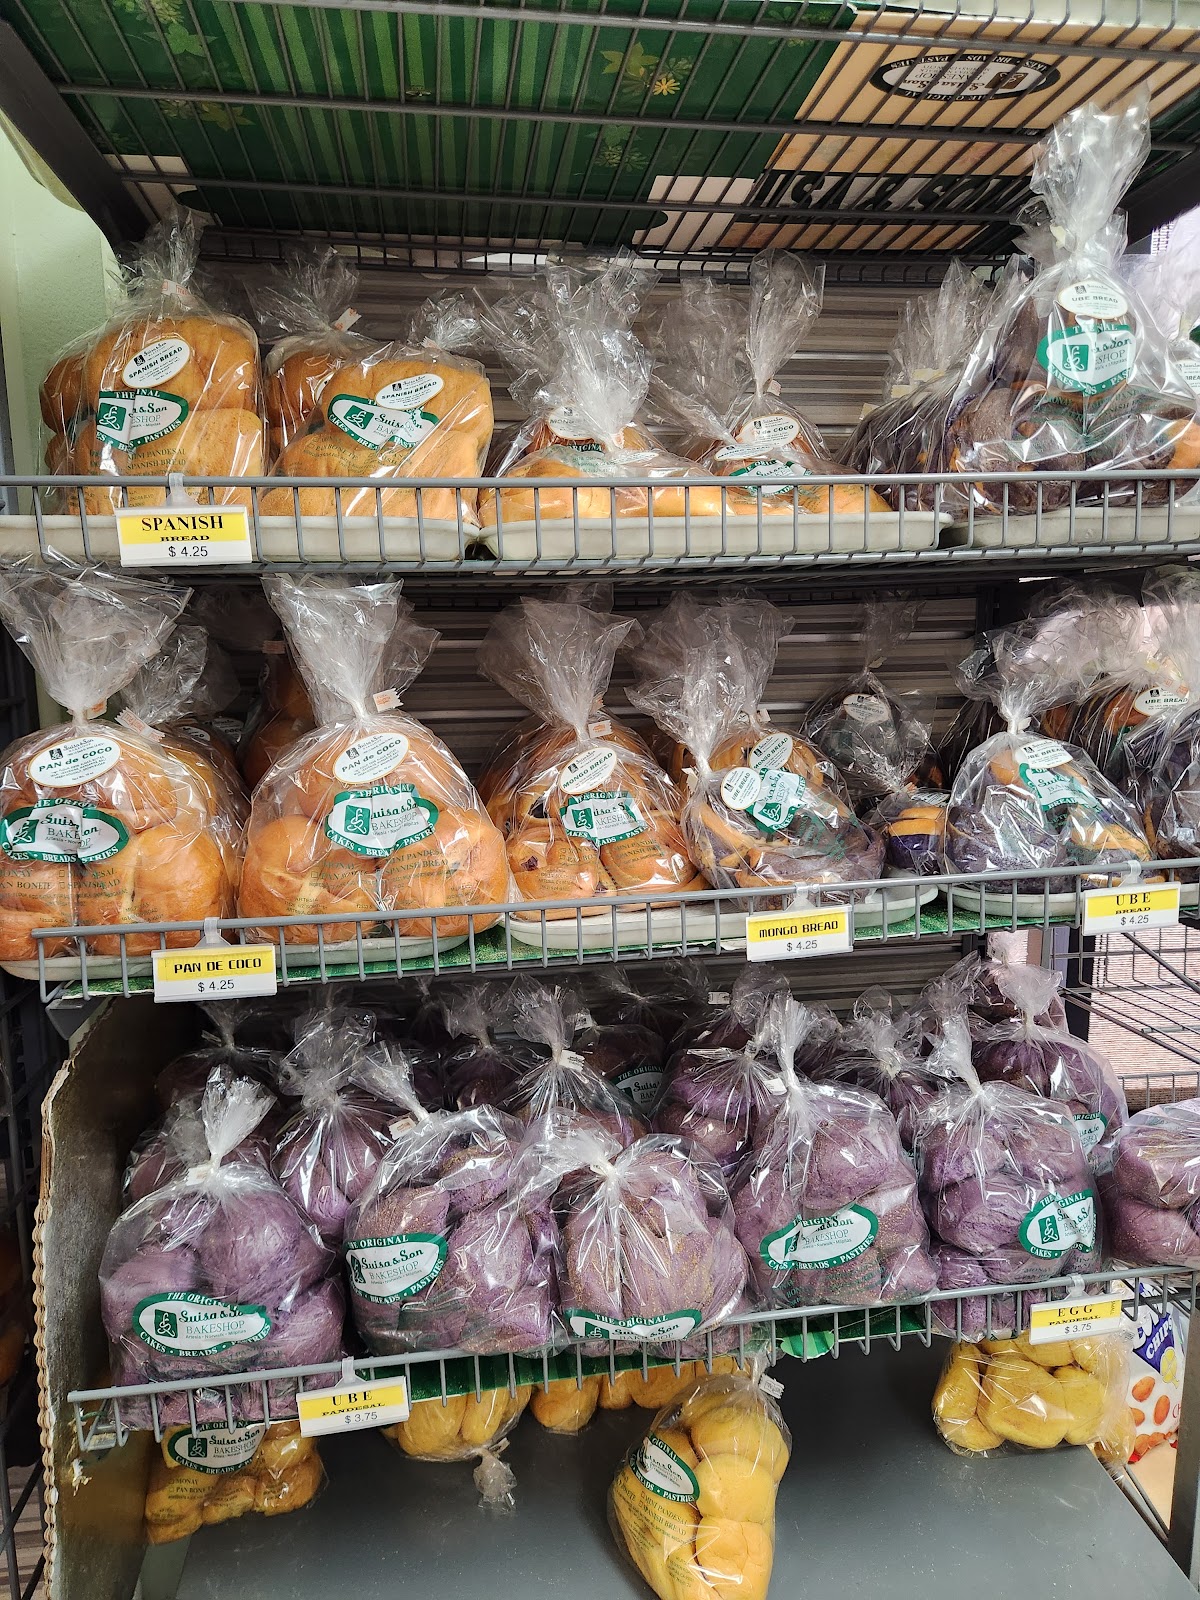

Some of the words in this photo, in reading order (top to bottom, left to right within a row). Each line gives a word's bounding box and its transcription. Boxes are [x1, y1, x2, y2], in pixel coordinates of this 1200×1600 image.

[890, 55, 950, 70] PASTIES
[128, 359, 159, 379] SPANISH
[159, 346, 183, 362] BREAD
[114, 391, 136, 399] THE
[381, 390, 414, 400] SPANISH
[414, 381, 438, 394] BREAD
[143, 418, 183, 444] PASTRIES
[329, 413, 350, 433] CAKES
[773, 424, 794, 434] COCO
[142, 515, 224, 531] SPANISH
[168, 545, 177, 558] $
[180, 546, 208, 557] 4.25
[38, 762, 62, 772] PAN
[82, 746, 112, 760] COCO
[341, 760, 361, 773] PAN
[363, 754, 374, 762] de
[376, 739, 401, 755] COCO
[753, 753, 772, 769] MONGO
[771, 737, 789, 755] BREAD
[563, 769, 589, 789] MONGO
[590, 752, 613, 771] BREAD
[372, 783, 412, 796] RIGINAL
[731, 788, 741, 801] UBE
[739, 772, 751, 791] BREAD
[371, 807, 400, 820] uisa
[326, 829, 355, 851] CAKES
[2, 841, 30, 861] CAKES
[42, 853, 78, 863] BREADS
[1116, 892, 1151, 906] UBE
[1115, 906, 1151, 915] BREAD
[1120, 917, 1127, 926] $
[1129, 915, 1149, 925] 4.25
[759, 925, 798, 938] MONGO
[802, 920, 838, 933] BREAD
[786, 942, 793, 952] $
[796, 940, 818, 951] 4.25
[174, 962, 201, 974] PAN
[206, 961, 224, 972] DE
[228, 957, 261, 970] COCO
[197, 981, 205, 993] $
[209, 979, 235, 991] 4.25
[359, 1234, 409, 1247] ORIGINAL
[839, 1233, 875, 1263] PASTRIES
[361, 1256, 392, 1270] Suisa
[392, 1256, 401, 1265] &
[400, 1248, 424, 1262] Son
[1030, 1246, 1052, 1258] CAKES
[368, 1260, 420, 1280] BAKESHOP
[409, 1257, 444, 1295] PASTRIES
[167, 1292, 186, 1301] THE
[178, 1309, 218, 1324] Suisa
[219, 1309, 230, 1319] &
[1057, 1304, 1093, 1317] EGG
[185, 1319, 245, 1335] BAKESHOP
[594, 1314, 616, 1325] THE
[618, 1314, 669, 1328] ORIGINAL
[1048, 1315, 1101, 1326] PANDESAL
[1064, 1326, 1070, 1334] $
[1072, 1322, 1092, 1333] 3.75
[658, 1323, 680, 1335] Son
[139, 1331, 168, 1354] CAKES
[178, 1346, 219, 1358] BREADS
[331, 1390, 373, 1406] UBE
[321, 1402, 385, 1417] PANDESAL
[344, 1415, 352, 1425] $
[354, 1411, 378, 1423] 3.75
[208, 1434, 236, 1446] Suisa
[244, 1428, 261, 1441] Son
[175, 1454, 199, 1470] CAKES
[205, 1466, 236, 1474] BREADS
